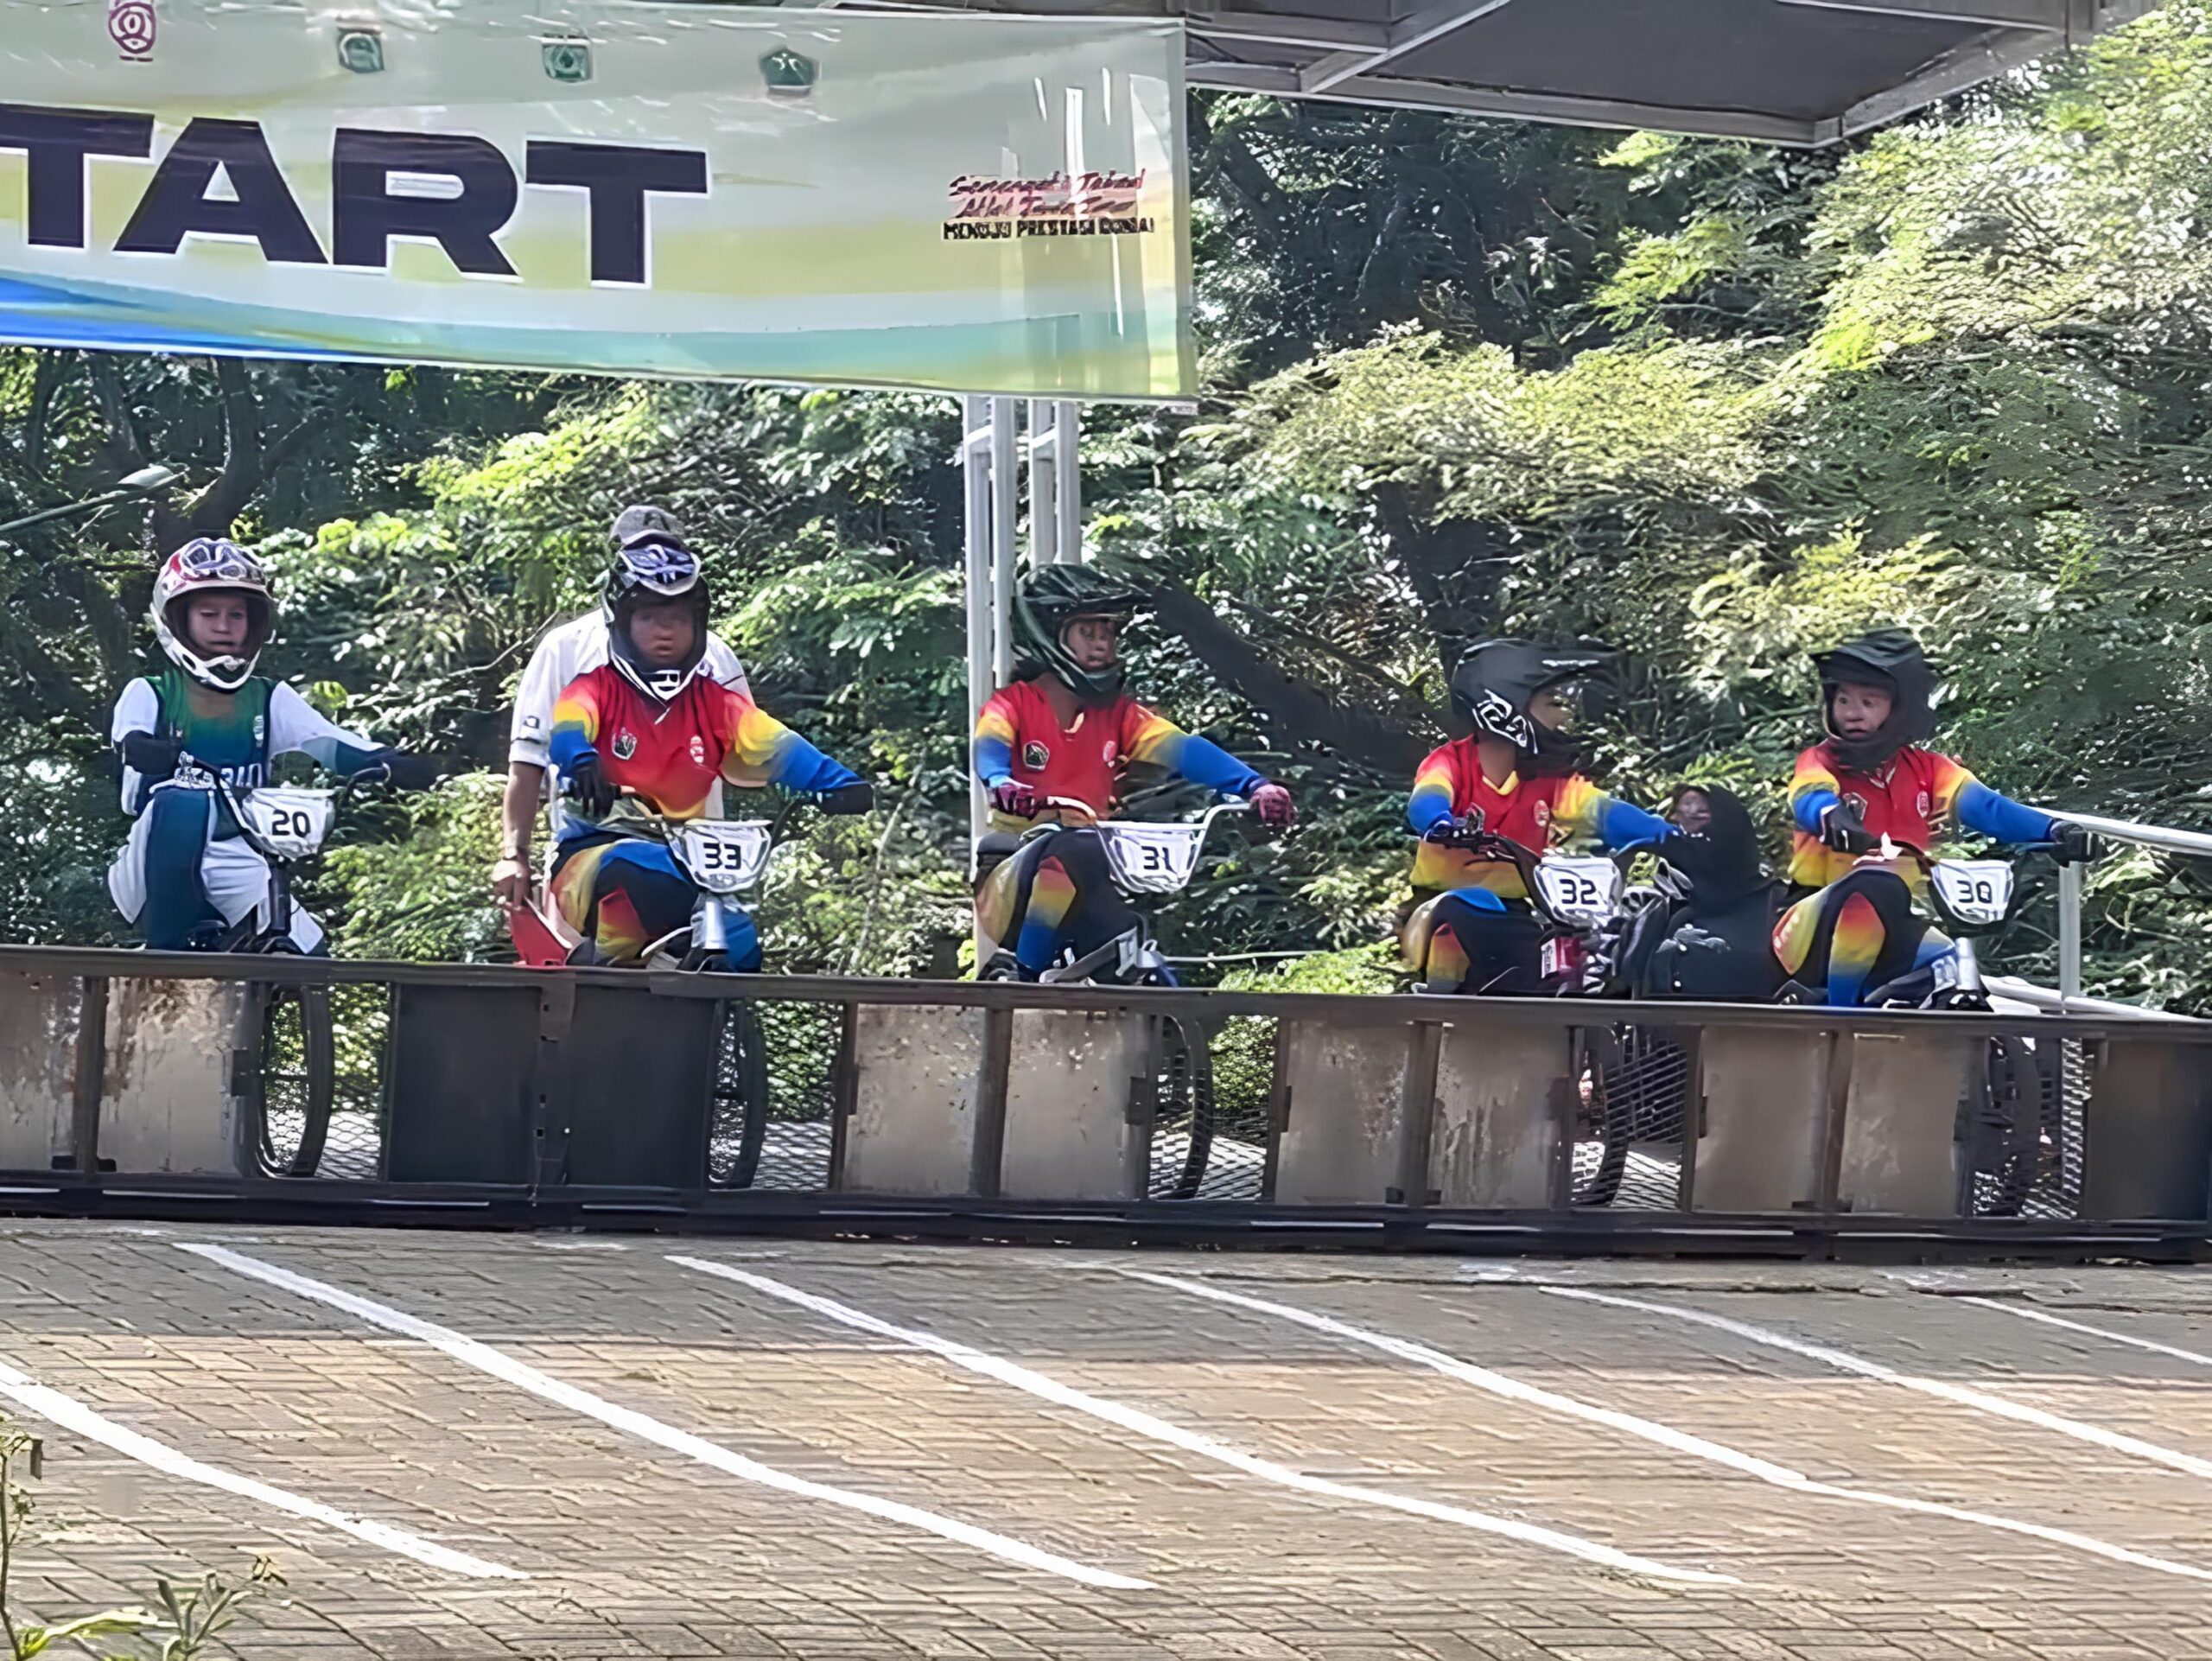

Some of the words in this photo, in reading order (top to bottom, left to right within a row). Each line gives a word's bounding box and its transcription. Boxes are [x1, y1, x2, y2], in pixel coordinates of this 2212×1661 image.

[0, 102, 709, 286] TART
[271, 808, 311, 837] 20
[703, 842, 741, 870] 33
[1141, 844, 1172, 871] 31
[1559, 878, 1599, 905] 32
[1956, 878, 1993, 904] 30
